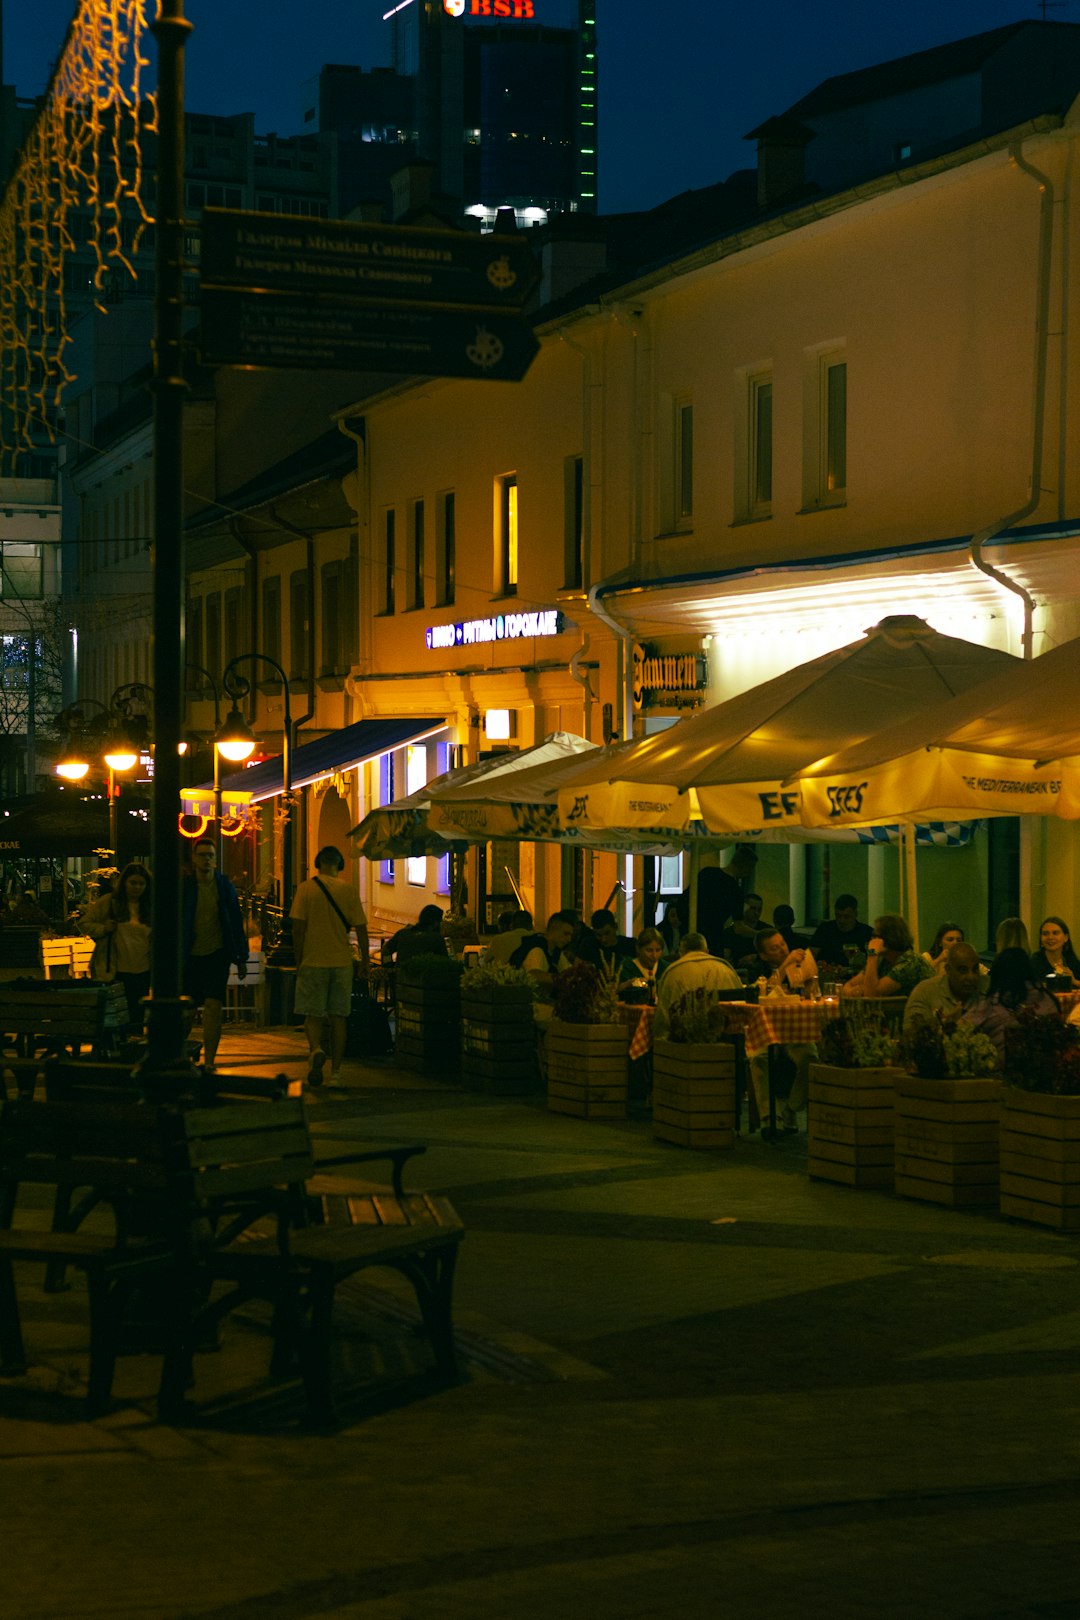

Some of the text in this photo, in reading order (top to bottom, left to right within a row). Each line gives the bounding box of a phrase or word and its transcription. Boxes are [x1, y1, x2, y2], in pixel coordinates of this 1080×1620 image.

[469, 0, 535, 18] BSB
[505, 610, 558, 638] ГОРОЖАНЕ
[826, 782, 868, 817] EFES
